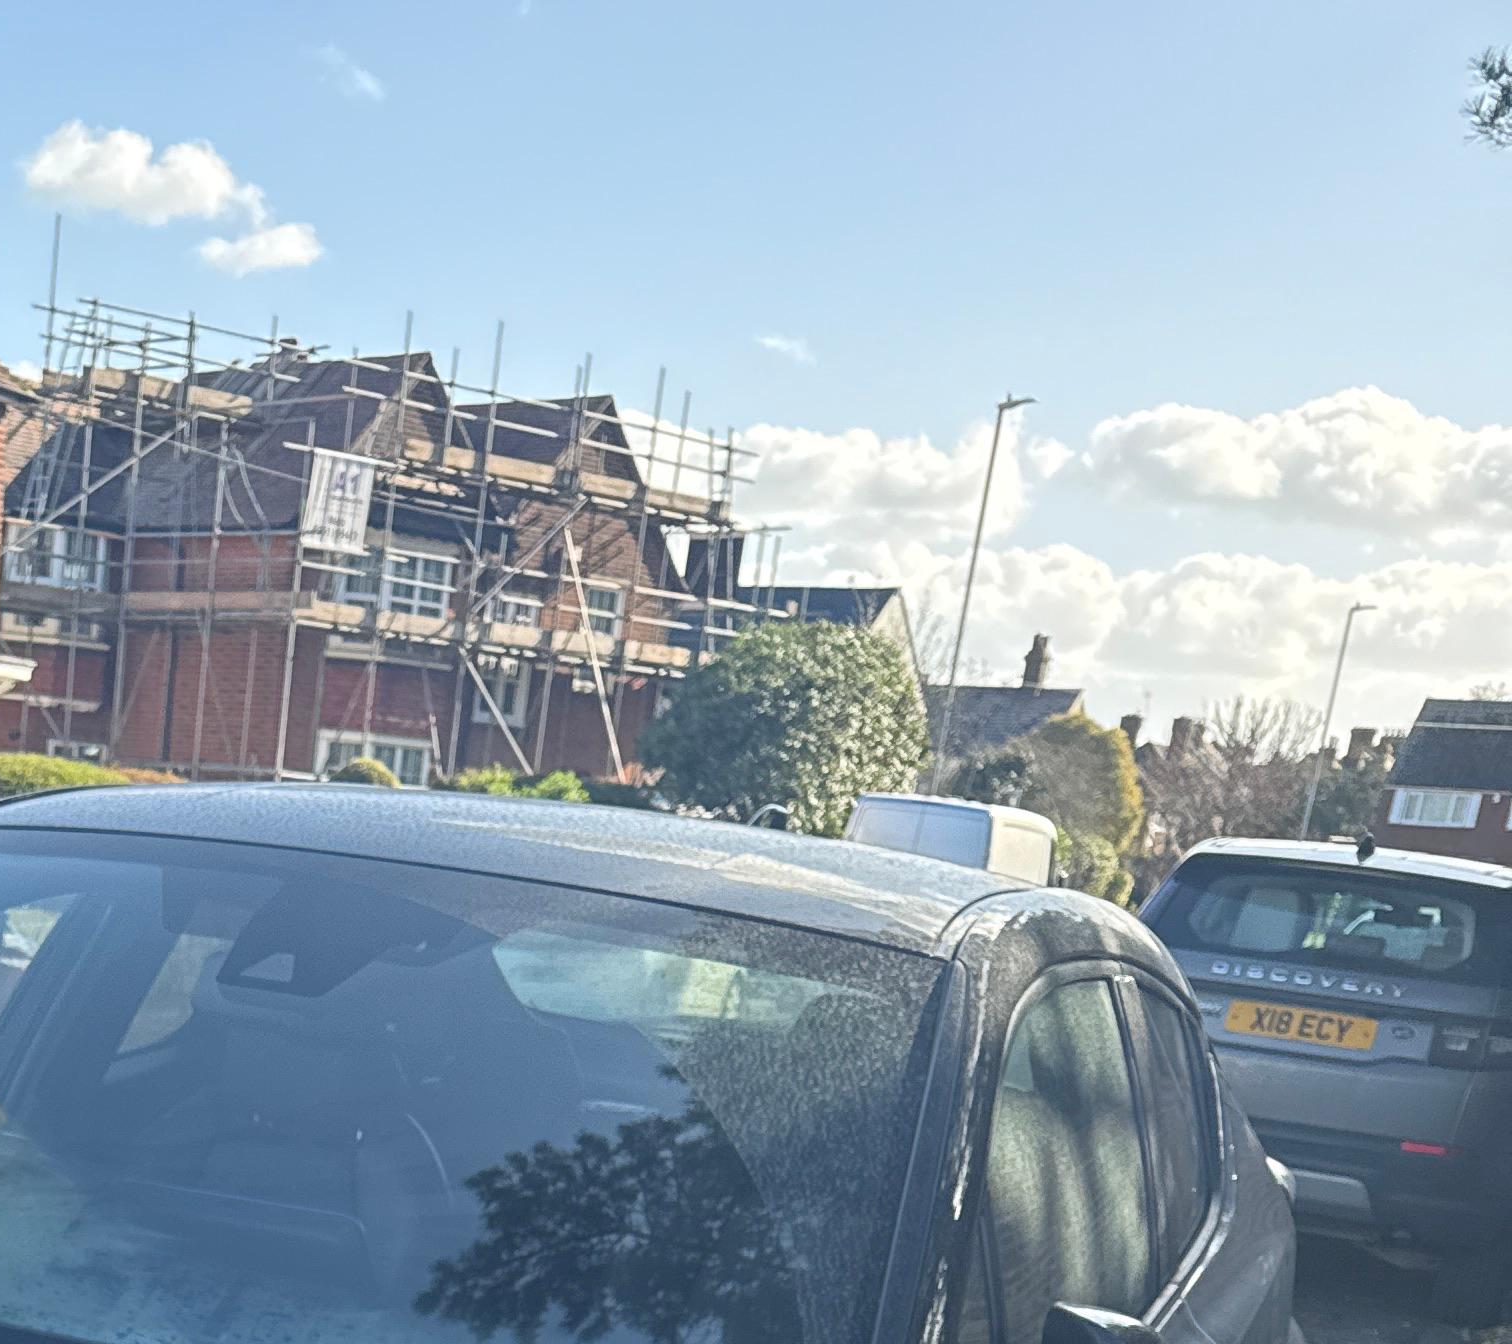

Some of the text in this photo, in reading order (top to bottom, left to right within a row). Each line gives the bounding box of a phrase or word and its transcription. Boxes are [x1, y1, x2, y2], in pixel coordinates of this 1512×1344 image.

[1211, 960, 1407, 998] DISCOVERY
[1249, 1007, 1294, 1035] X18
[1297, 1013, 1354, 1043] ECY
